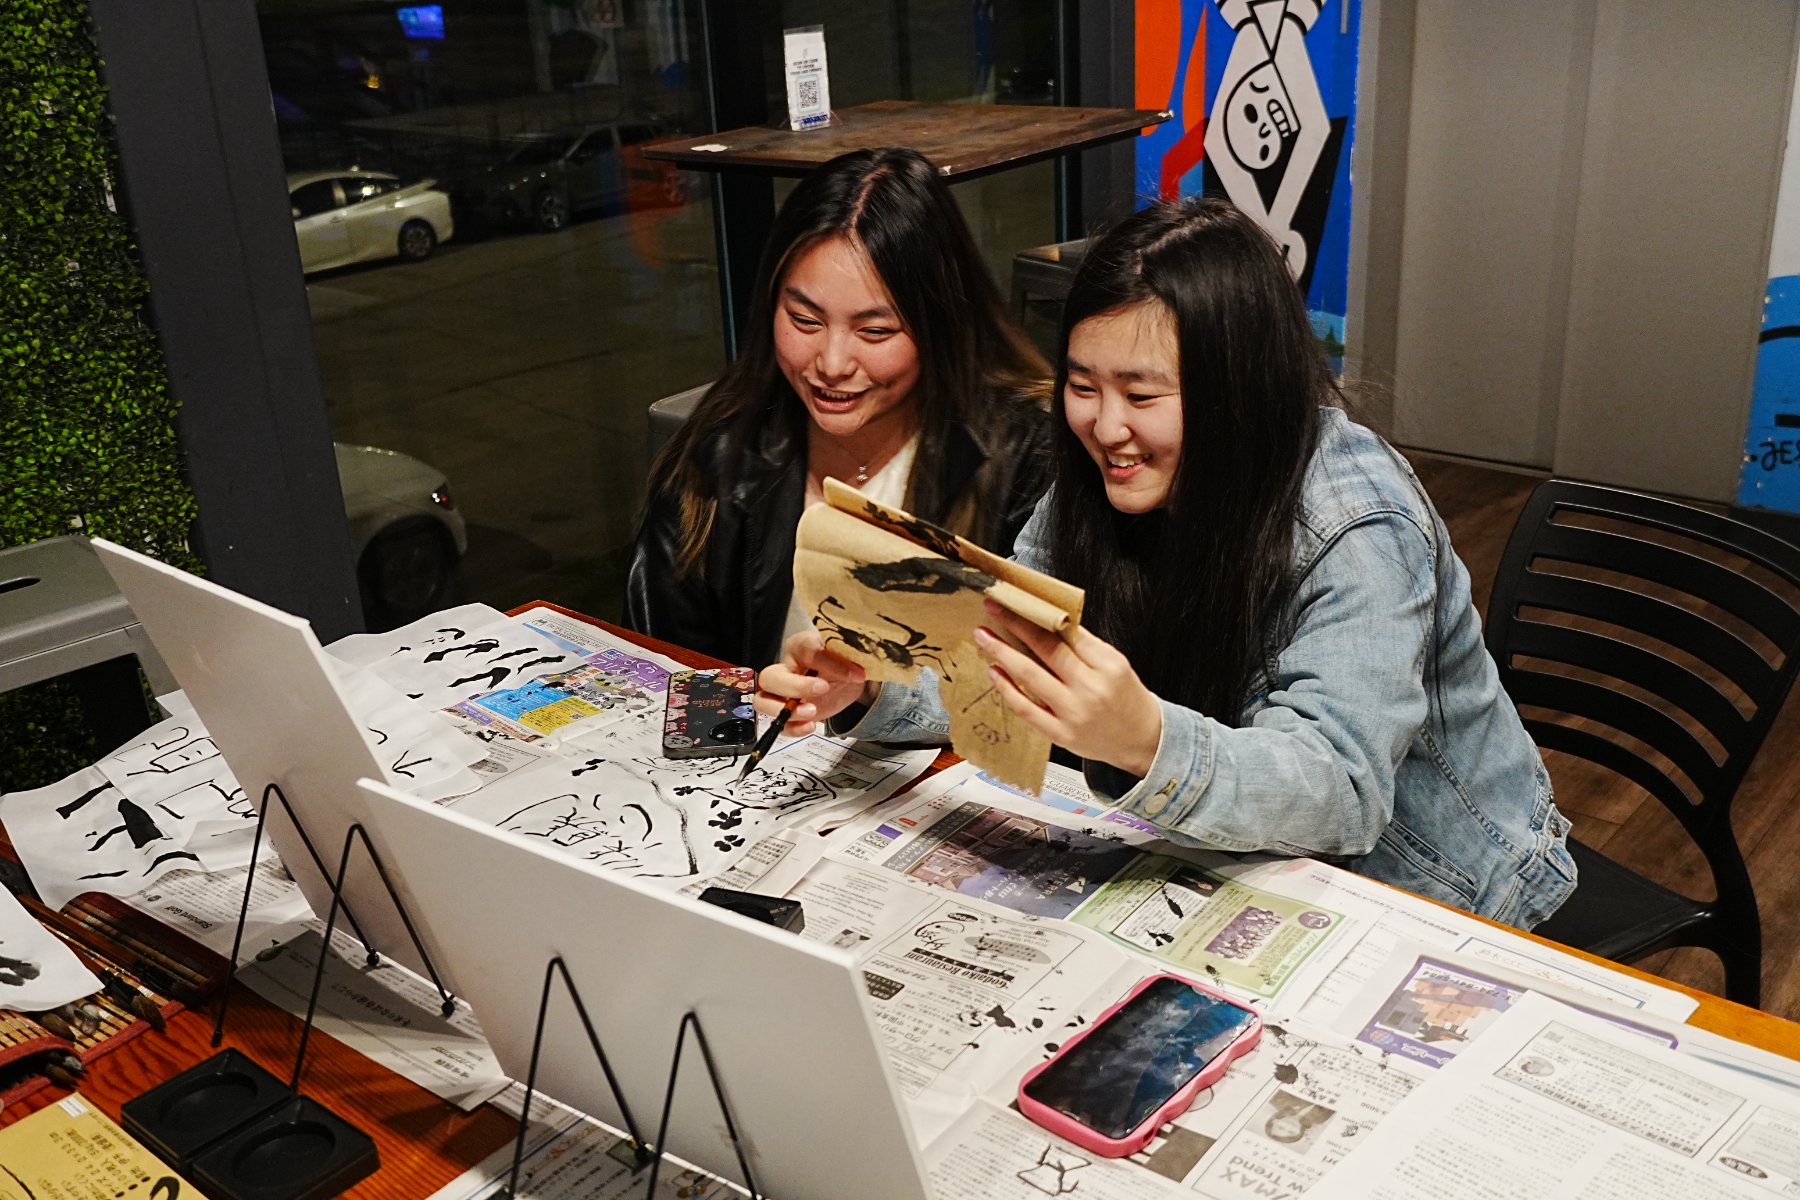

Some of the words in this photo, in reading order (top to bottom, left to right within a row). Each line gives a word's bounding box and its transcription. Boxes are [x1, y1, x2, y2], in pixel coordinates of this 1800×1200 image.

[164, 904, 182, 915] Golf
[180, 911, 212, 929] Standard
[903, 950, 961, 973] Restaurant
[959, 969, 1008, 990] Godaiko
[1228, 1154, 1283, 1184] Trend
